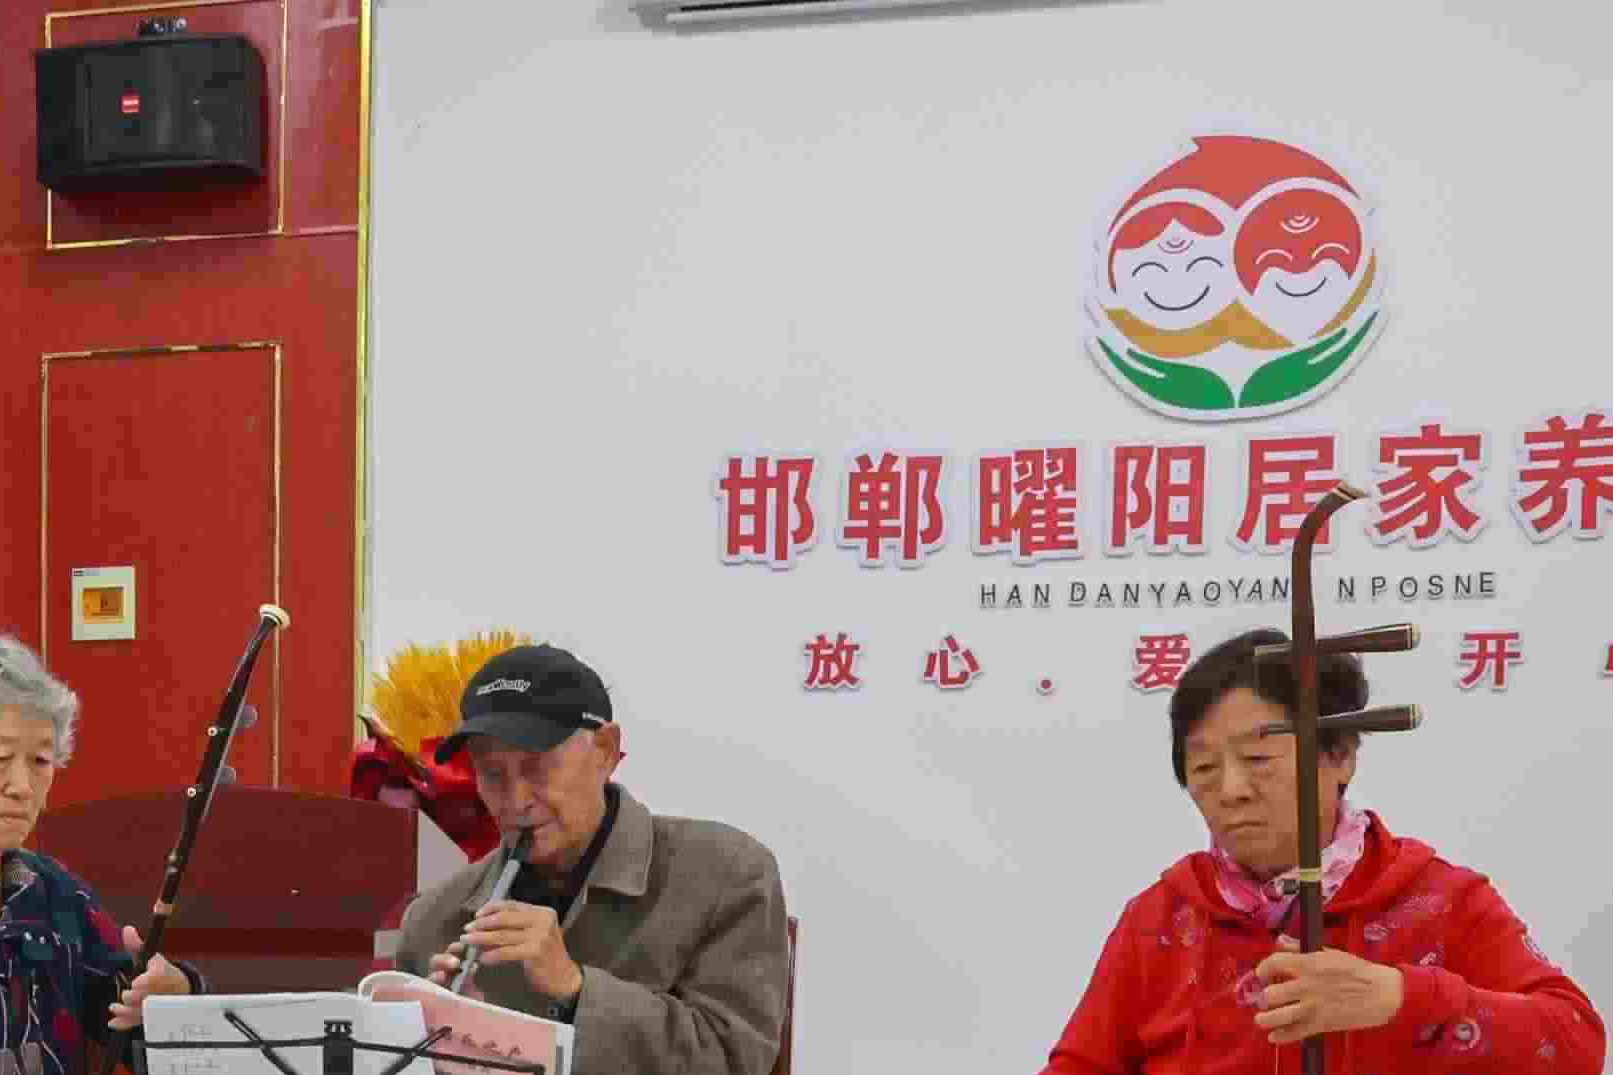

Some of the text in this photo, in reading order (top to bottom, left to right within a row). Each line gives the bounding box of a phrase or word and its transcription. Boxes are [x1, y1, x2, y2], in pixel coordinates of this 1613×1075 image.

[719, 414, 1613, 561] 邯郸曜阳居家养
[979, 583, 1052, 606] HAN
[1068, 577, 1291, 606] DANYAOYAN
